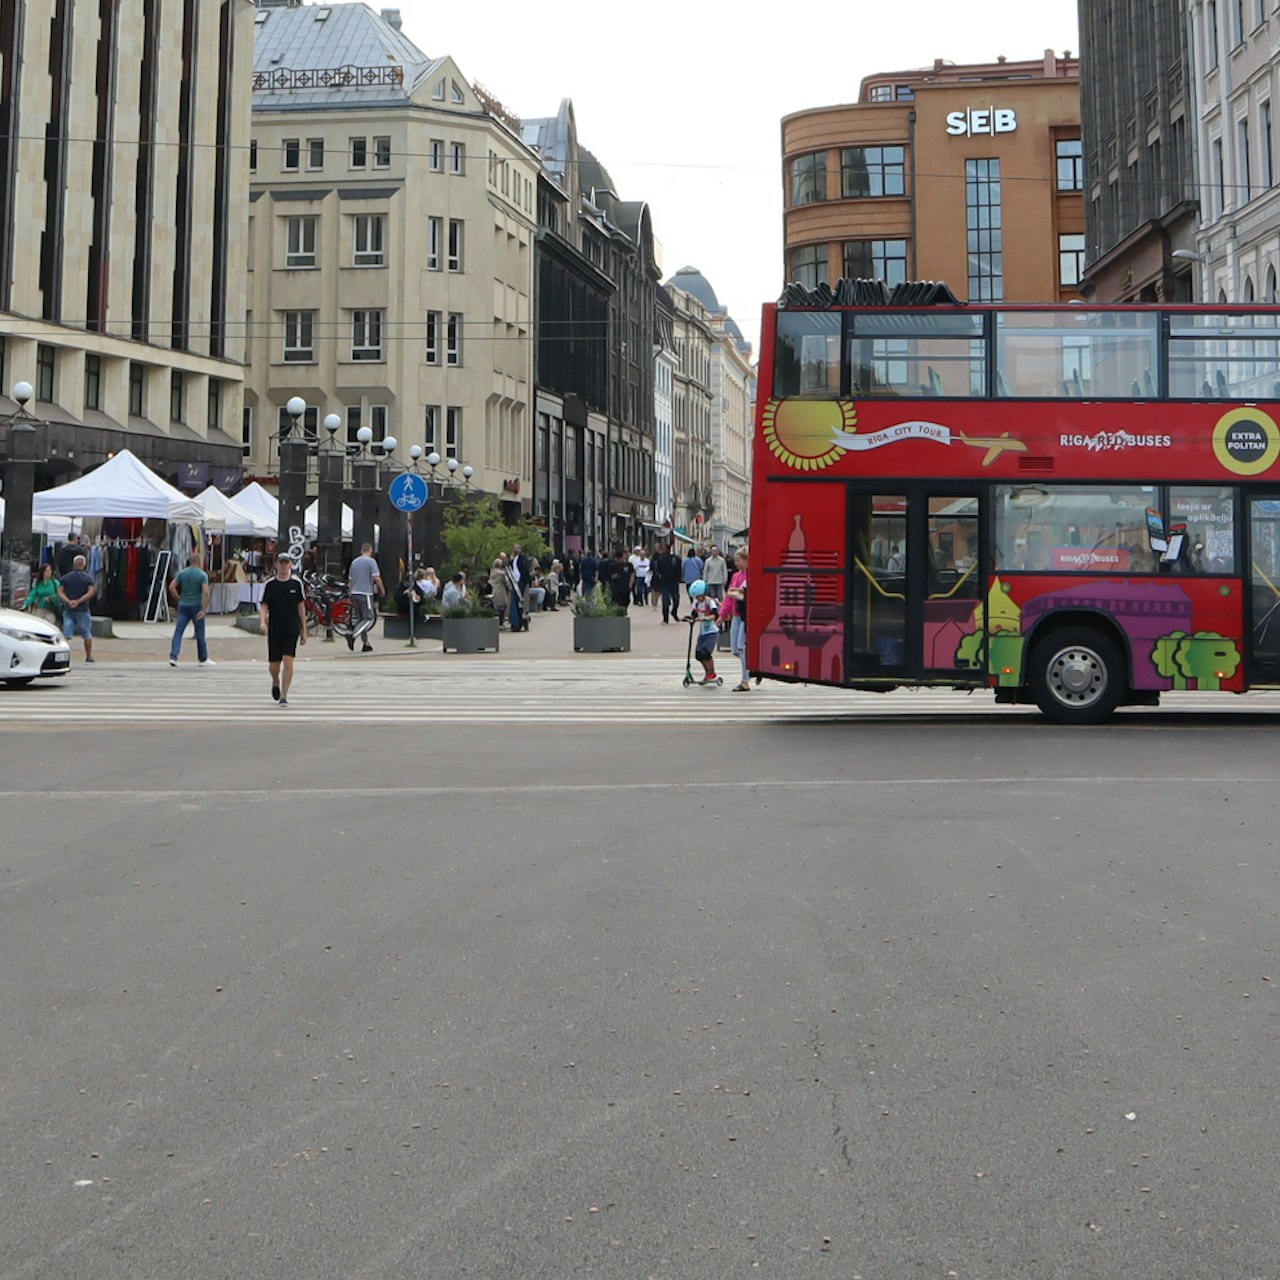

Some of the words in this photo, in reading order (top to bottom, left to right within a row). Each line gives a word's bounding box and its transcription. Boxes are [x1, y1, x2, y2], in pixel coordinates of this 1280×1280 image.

[946, 108, 1017, 136] SEB
[867, 432, 889, 446] RIGA
[894, 425, 913, 436] CITY
[918, 425, 942, 438] TOUR
[1060, 434, 1090, 447] RIGA
[1127, 434, 1172, 447] BUSES
[1231, 432, 1262, 440] EXTRA
[1227, 441, 1266, 450] POLITAN
